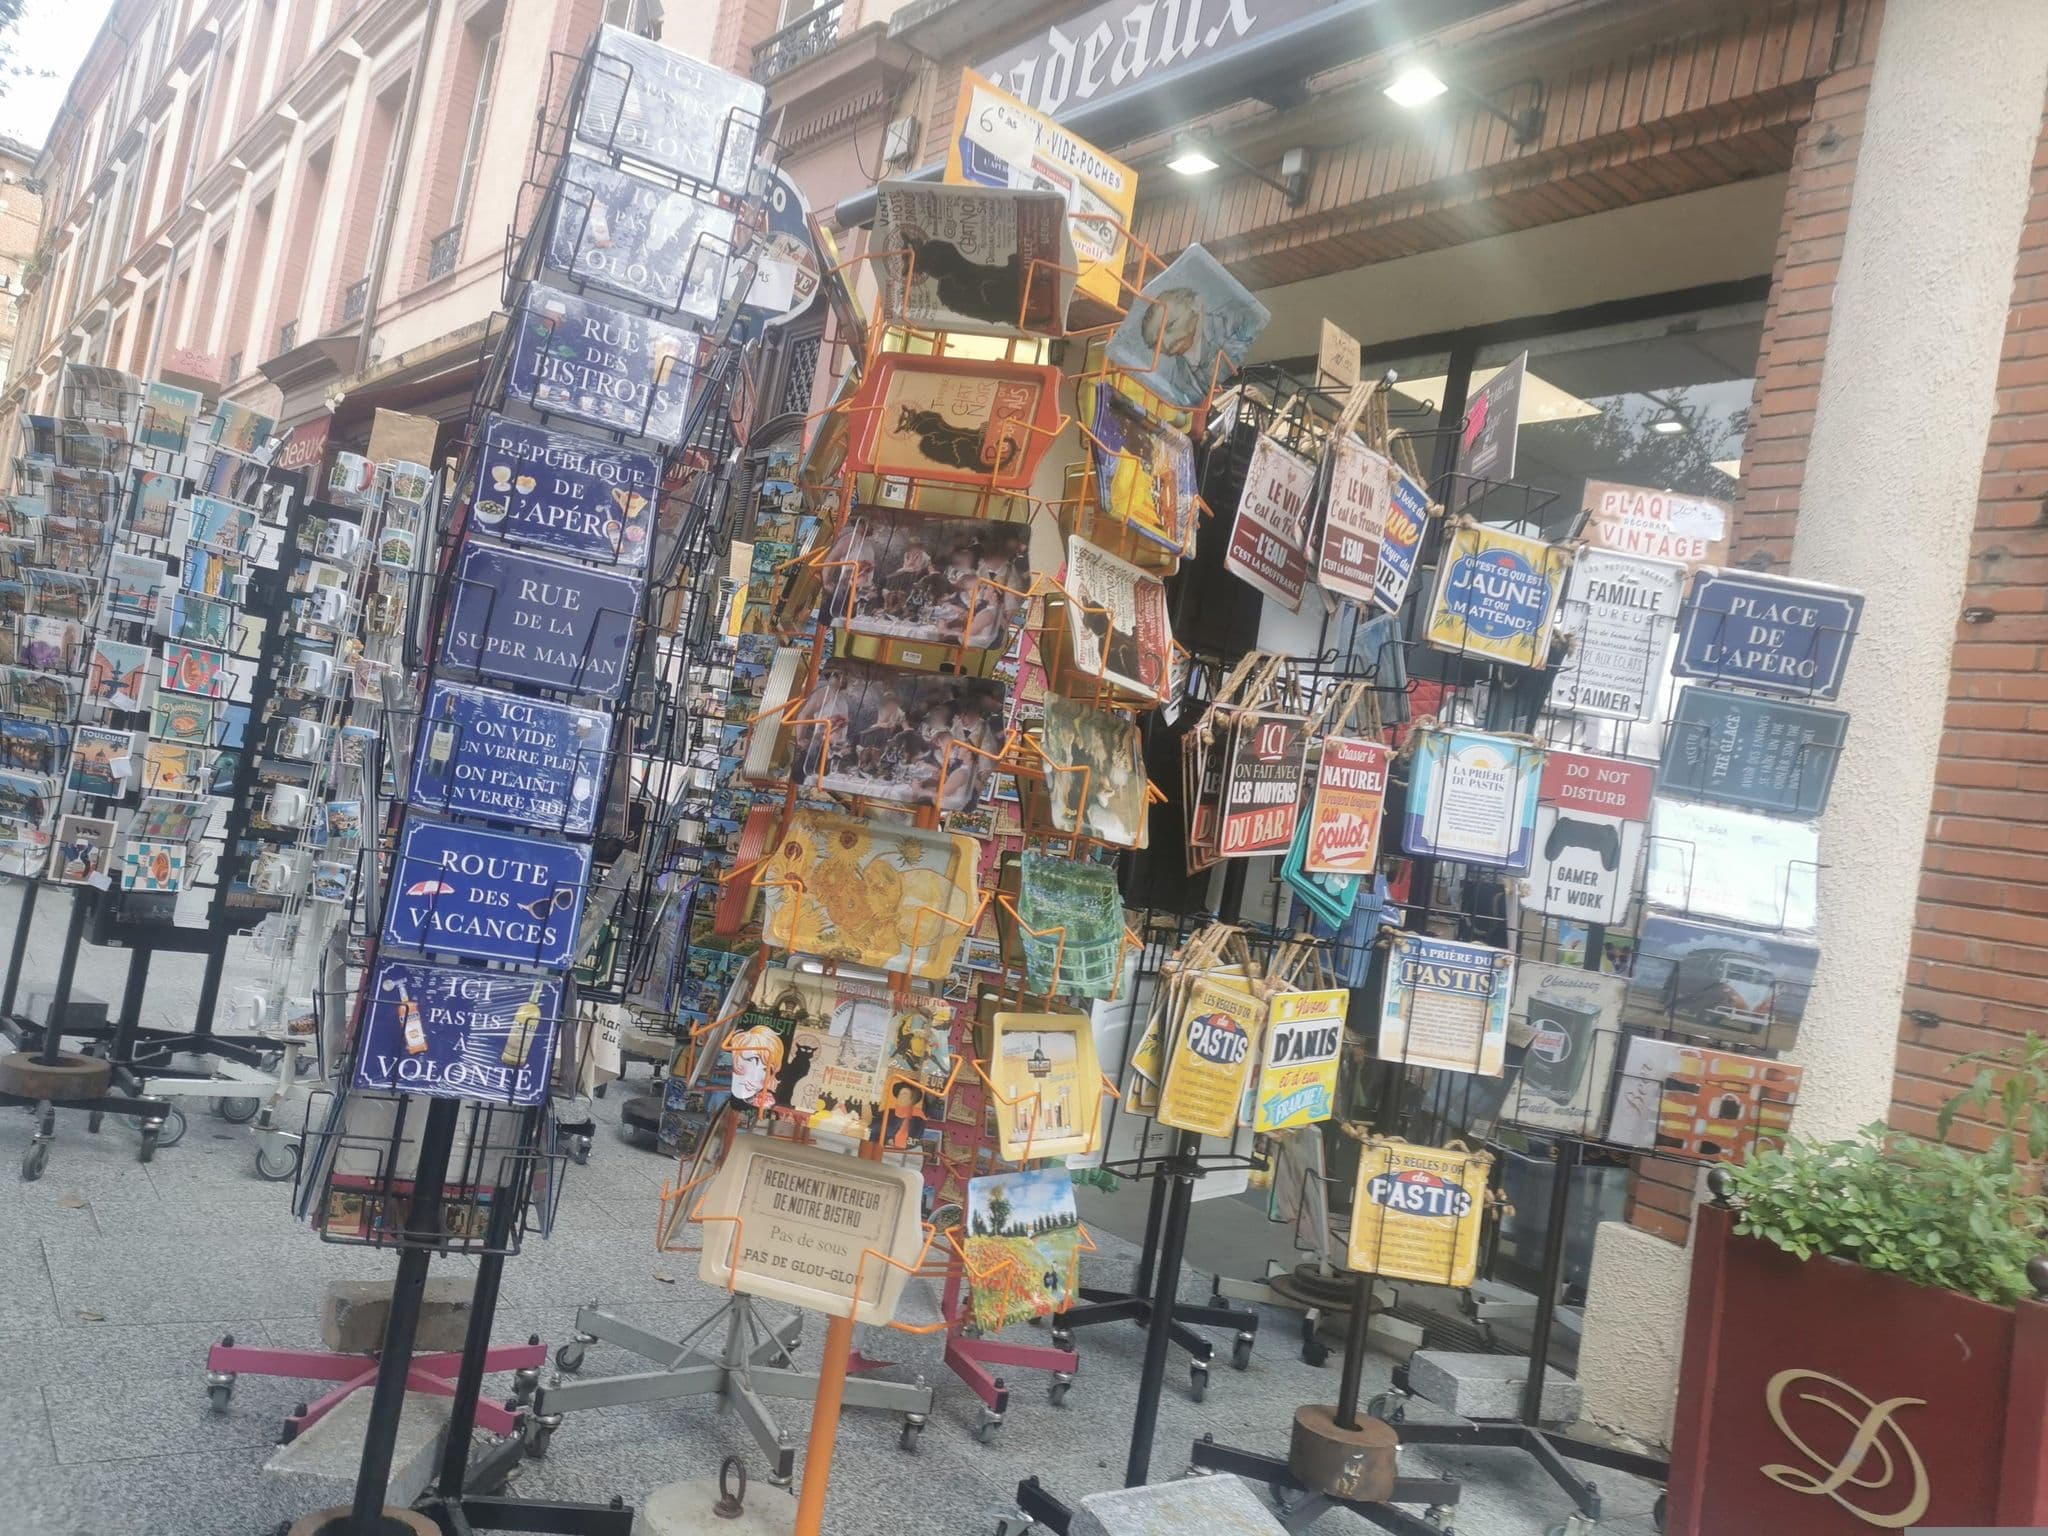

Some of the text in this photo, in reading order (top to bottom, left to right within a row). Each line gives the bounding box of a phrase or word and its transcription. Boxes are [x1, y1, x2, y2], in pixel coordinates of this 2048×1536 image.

[664, 59, 704, 89] ICI
[582, 317, 640, 353] RUE
[586, 348, 629, 374] DES
[531, 352, 672, 413] BISTROTS
[499, 437, 645, 487] RÉPUBLIQUE
[553, 479, 585, 499] DE
[1268, 479, 1280, 504] LE
[1348, 478, 1375, 511] LE VIN
[503, 495, 624, 540] L'APÉRO
[1359, 510, 1383, 537] France
[1386, 507, 1420, 547] une
[1256, 533, 1288, 568] L'EAU
[1340, 536, 1364, 565] L'EAU
[1604, 525, 1705, 557] VINTAGE
[1233, 545, 1301, 595] C'EST LA SOUFFRANCE
[1323, 558, 1337, 571] C'EST
[1337, 563, 1345, 573] LA
[1497, 567, 1510, 578] CE
[1510, 570, 1527, 583] QUI
[1526, 573, 1543, 587] EST
[518, 579, 581, 611] RUE
[1453, 570, 1545, 610] JAUNE
[1482, 597, 1510, 611] ET QUI
[1586, 580, 1663, 612] FAMILLE
[513, 611, 575, 637] DE LA
[1728, 596, 1819, 628] PLACE
[1747, 626, 1786, 647] DE
[456, 631, 527, 659] SUPER
[534, 649, 617, 676] MAMAN
[1702, 643, 1818, 680] L'APÉRO
[1569, 685, 1631, 712] S'AIMER
[500, 703, 538, 728] ICI,
[82, 729, 130, 744] TOULOUSE
[476, 720, 557, 749] ON VIDE
[1259, 724, 1288, 756] ICI
[459, 739, 593, 777] UN VERRE PLEIN,
[1368, 749, 1377, 764] le
[455, 764, 560, 796] ON PLAINT
[1235, 763, 1300, 780] ON FAIT AVEC
[1323, 765, 1383, 792] NATUREL
[1453, 766, 1466, 777] LA
[1468, 779, 1505, 792] PASTIS
[1566, 763, 1631, 785] DO NOT
[442, 784, 466, 800] UN
[469, 787, 526, 812] VERRE
[1231, 781, 1297, 804] LES MOYENS
[1561, 784, 1627, 807] DISTURB
[1321, 807, 1340, 823] au
[1228, 816, 1252, 850] DU
[1252, 809, 1286, 844] BAR
[438, 849, 550, 887] ROUTE
[1557, 866, 1599, 887] GAMER
[468, 888, 510, 908] DES
[1544, 885, 1606, 909] AT WORK
[409, 907, 557, 946] VACANCES
[1411, 946, 1493, 966] LA PRIÈRE DU
[449, 976, 493, 1001] ICI
[1405, 961, 1493, 994] PASTIS
[429, 1007, 503, 1030] PASTIS
[1203, 992, 1216, 1006] LES
[1237, 1004, 1252, 1019] D'OR
[1187, 1021, 1249, 1065] PASTIS
[1271, 1026, 1340, 1063] D'ANIS
[377, 1054, 534, 1093] VOLONTÉ
[1384, 1153, 1400, 1166] LES
[1441, 1162, 1466, 1176] D'OR
[1411, 1171, 1430, 1185] du
[772, 1192, 863, 1228] DE NOTRE BISTRO
[1371, 1177, 1472, 1219] PASTIS
[769, 1225, 849, 1258] Pas de sous
[744, 1248, 769, 1264] PAS
[771, 1255, 789, 1269] DE
